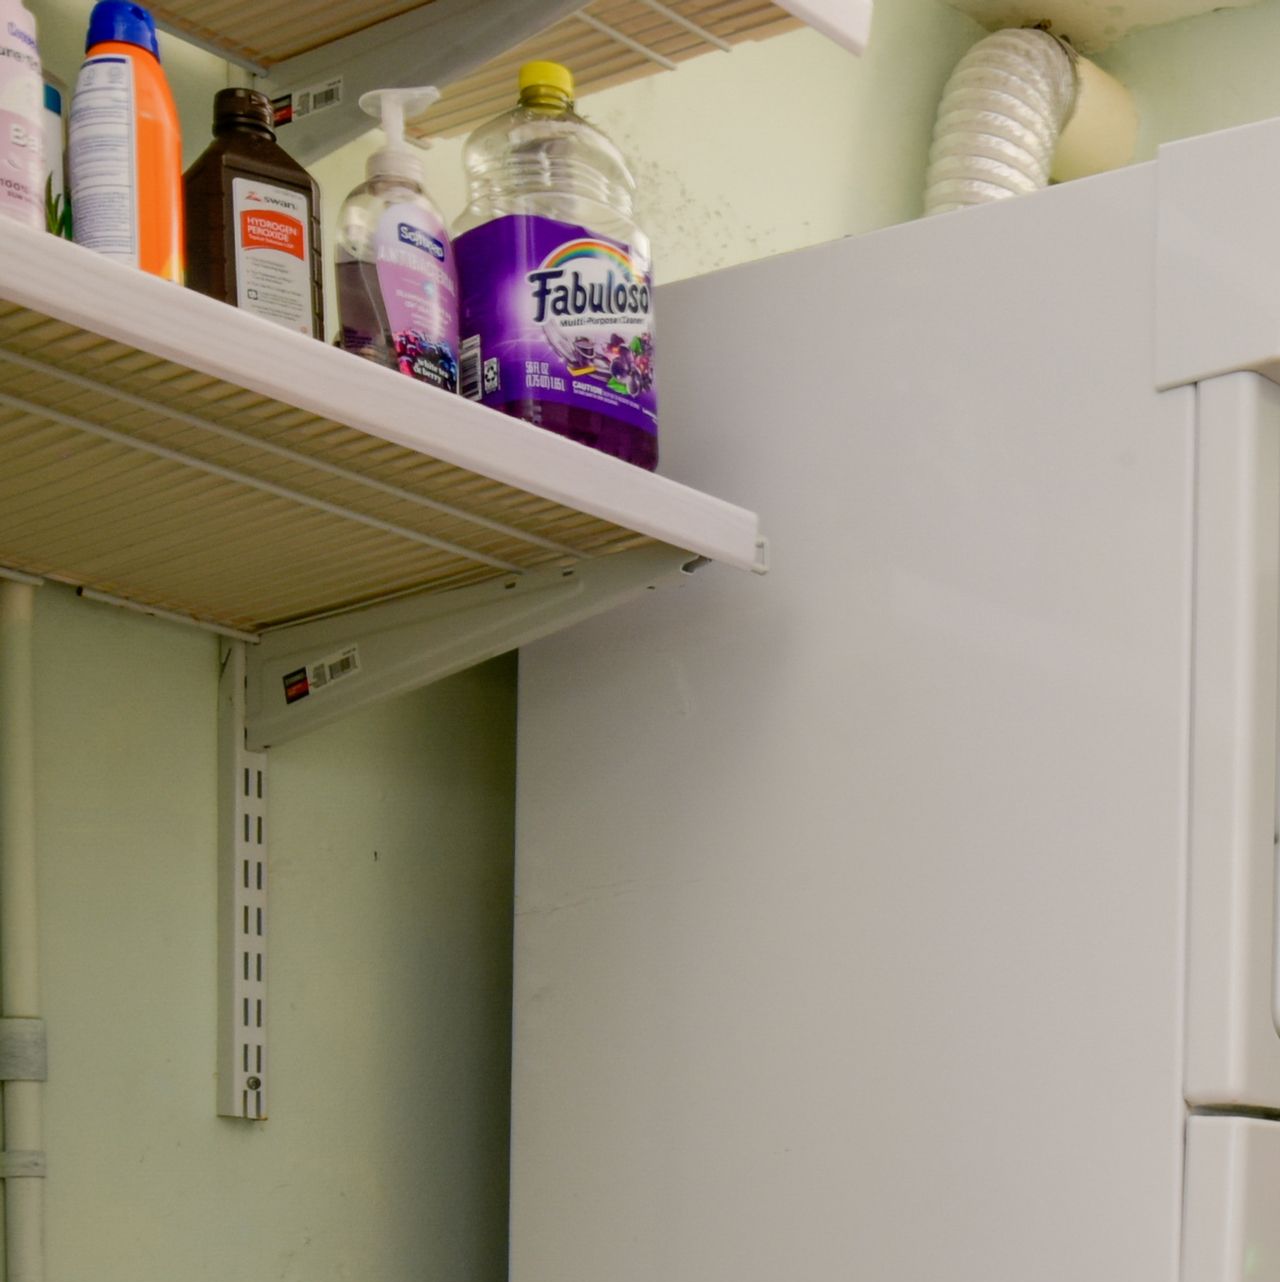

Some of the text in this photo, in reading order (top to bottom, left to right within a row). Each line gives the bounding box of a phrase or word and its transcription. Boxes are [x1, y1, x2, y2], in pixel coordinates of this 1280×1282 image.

[263, 195, 296, 210] swan
[246, 216, 298, 236] HYDROGEN
[247, 225, 290, 242] PEROXIDE
[528, 270, 649, 323] Fabuloso
[417, 358, 439, 373] white
[421, 368, 442, 384] berry
